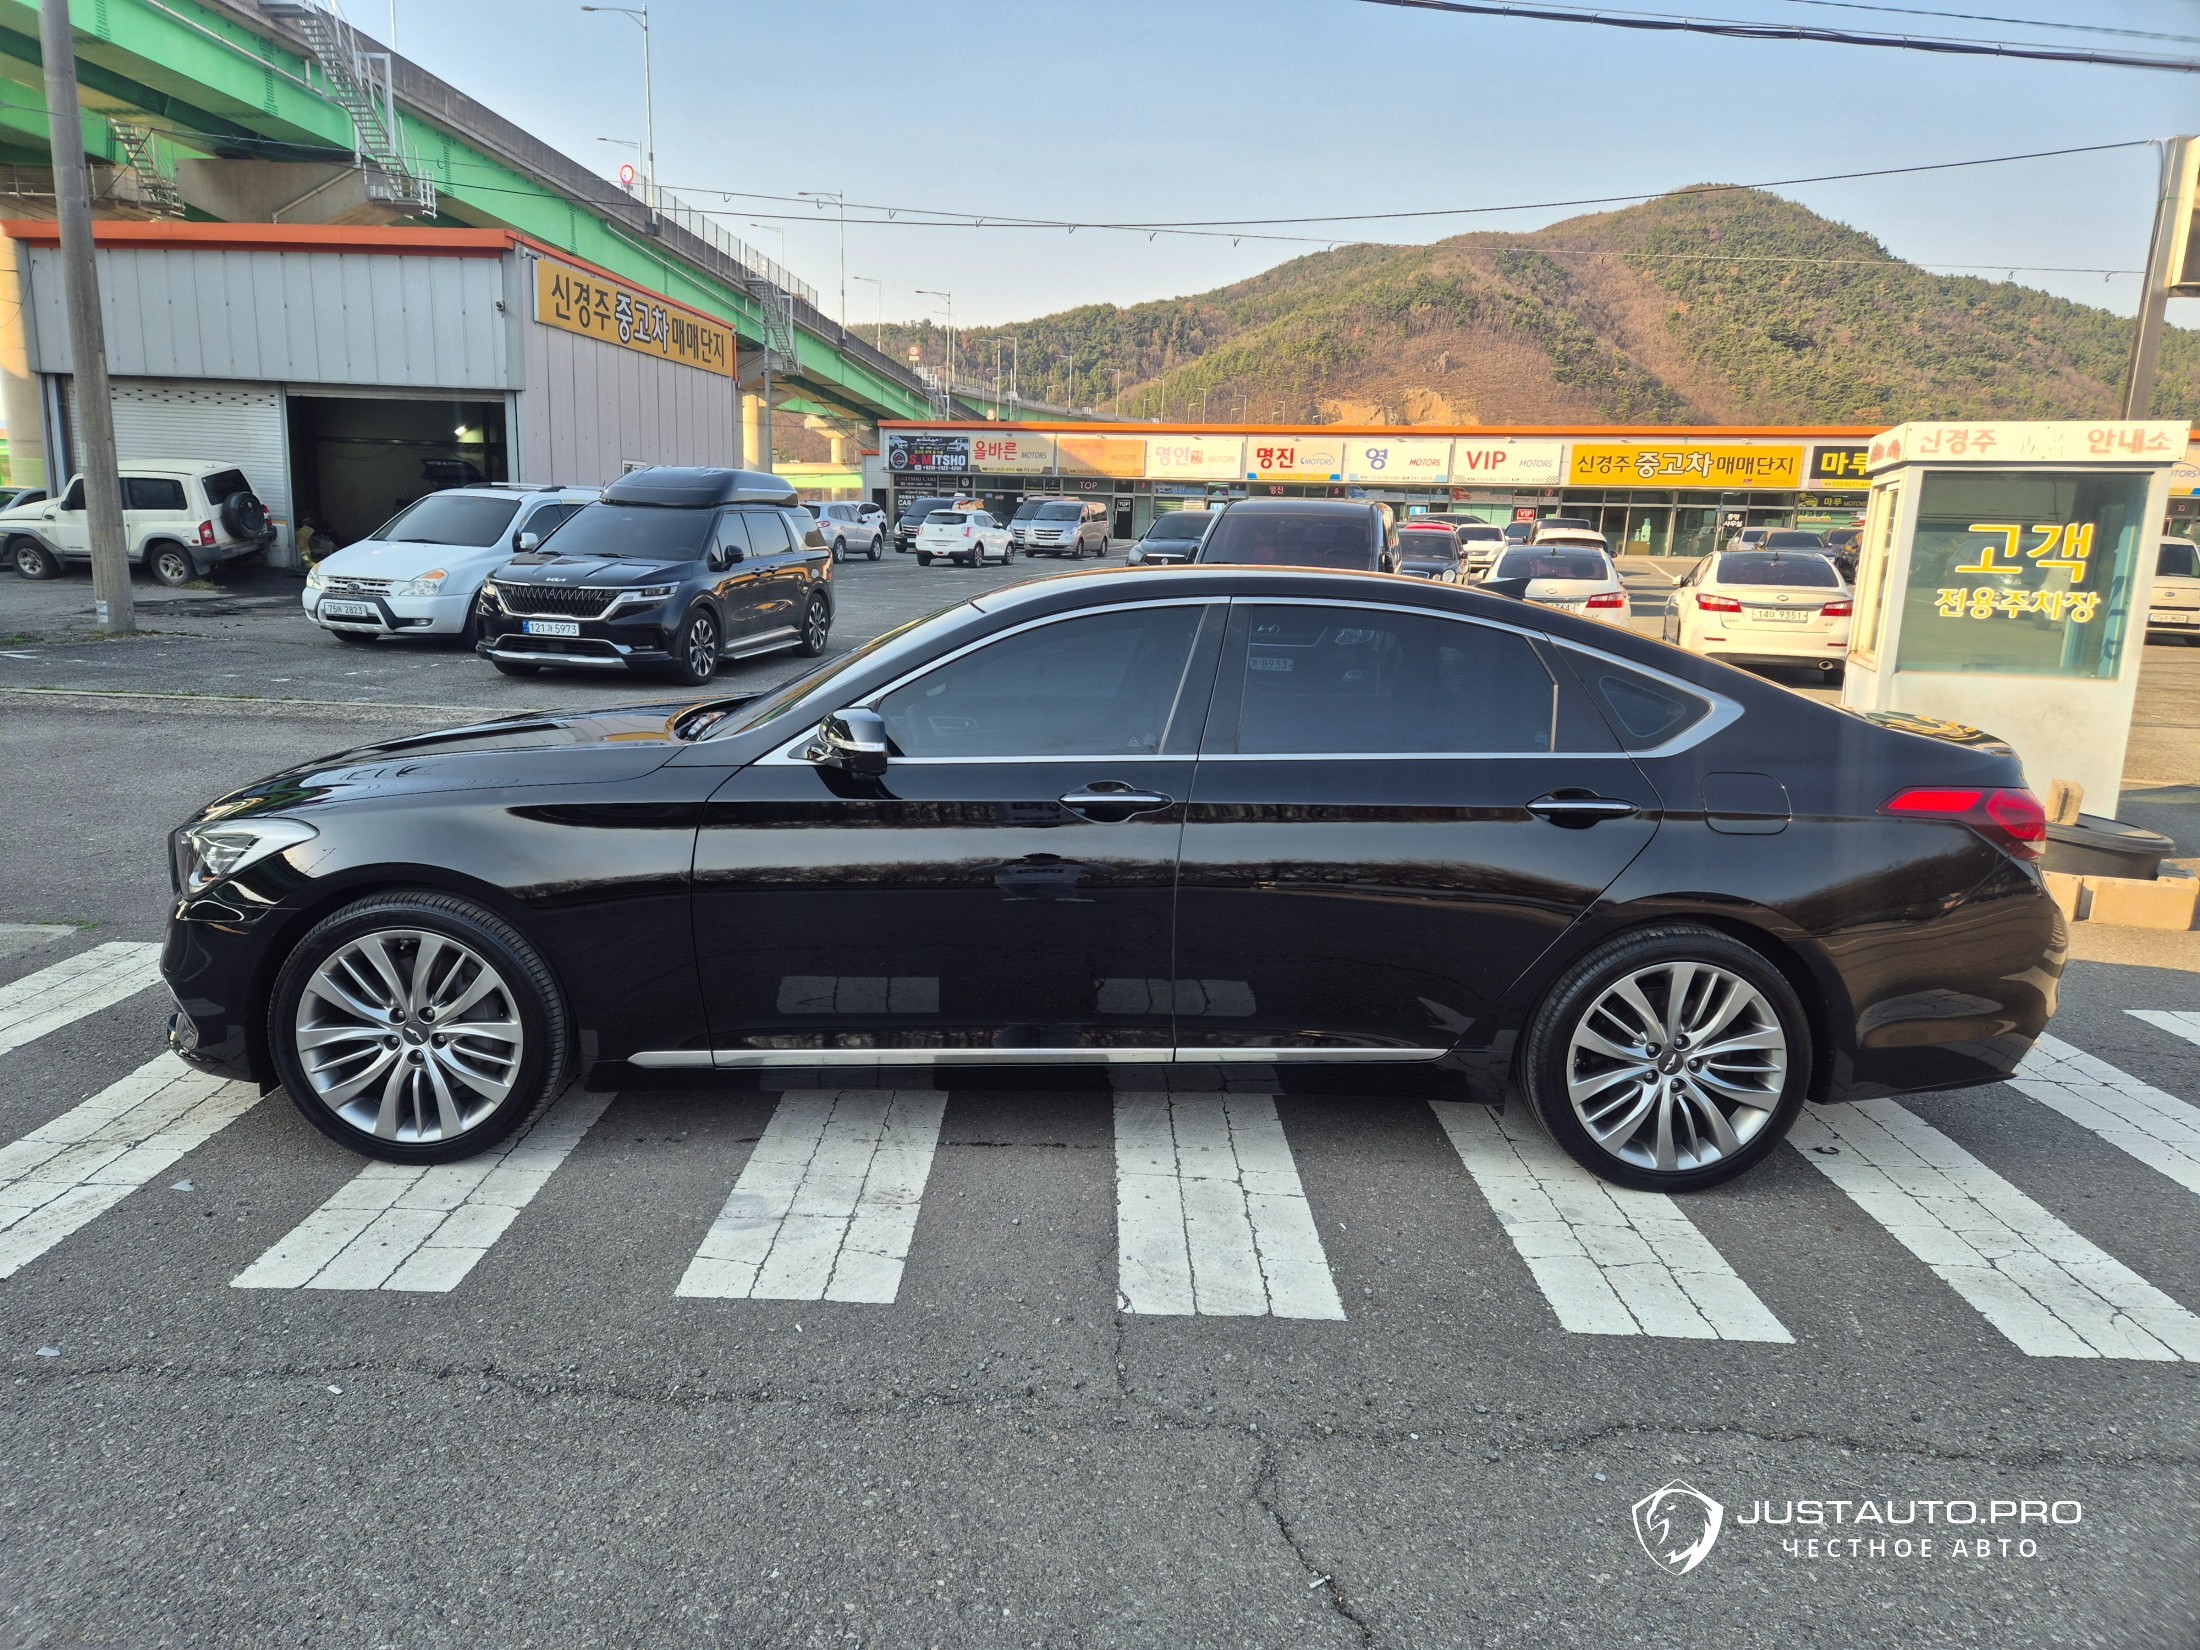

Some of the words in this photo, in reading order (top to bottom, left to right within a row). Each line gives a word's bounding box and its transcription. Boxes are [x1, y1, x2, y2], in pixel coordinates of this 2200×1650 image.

[551, 273, 612, 331] 신경주
[614, 291, 670, 354] 중고차
[671, 317, 725, 367] 매매단지
[1920, 428, 1997, 454] 신경주
[2087, 428, 2172, 454] 안내소
[973, 440, 1017, 460] 올바른
[1020, 451, 1047, 459] MOTORS
[1064, 443, 1104, 464] TOP
[1111, 453, 1137, 461] MOTORS
[1155, 446, 1189, 466] 명인
[1207, 455, 1236, 463] MOTORS
[1256, 447, 1294, 469] 명진
[1365, 447, 1388, 470] 영
[1466, 450, 1507, 470] VIP
[1303, 458, 1333, 466] MOTORS
[1409, 458, 1441, 466] MOTORS
[1518, 459, 1553, 468] MOTORS
[1577, 454, 1632, 474] 신경주
[1633, 450, 1714, 479] 중고차
[1715, 456, 1794, 475] 매매단지
[1820, 451, 1868, 476] 마루
[1080, 481, 1098, 490] TOP
[1269, 485, 1284, 495] 명진
[1823, 497, 1842, 506] 마루
[1954, 522, 2094, 584] 고객
[345, 605, 363, 614] 2823
[1934, 586, 2101, 623] 전용주차장
[1779, 611, 1801, 619] 9351
[555, 624, 577, 634] 5973
[1262, 659, 1288, 669] 8933
